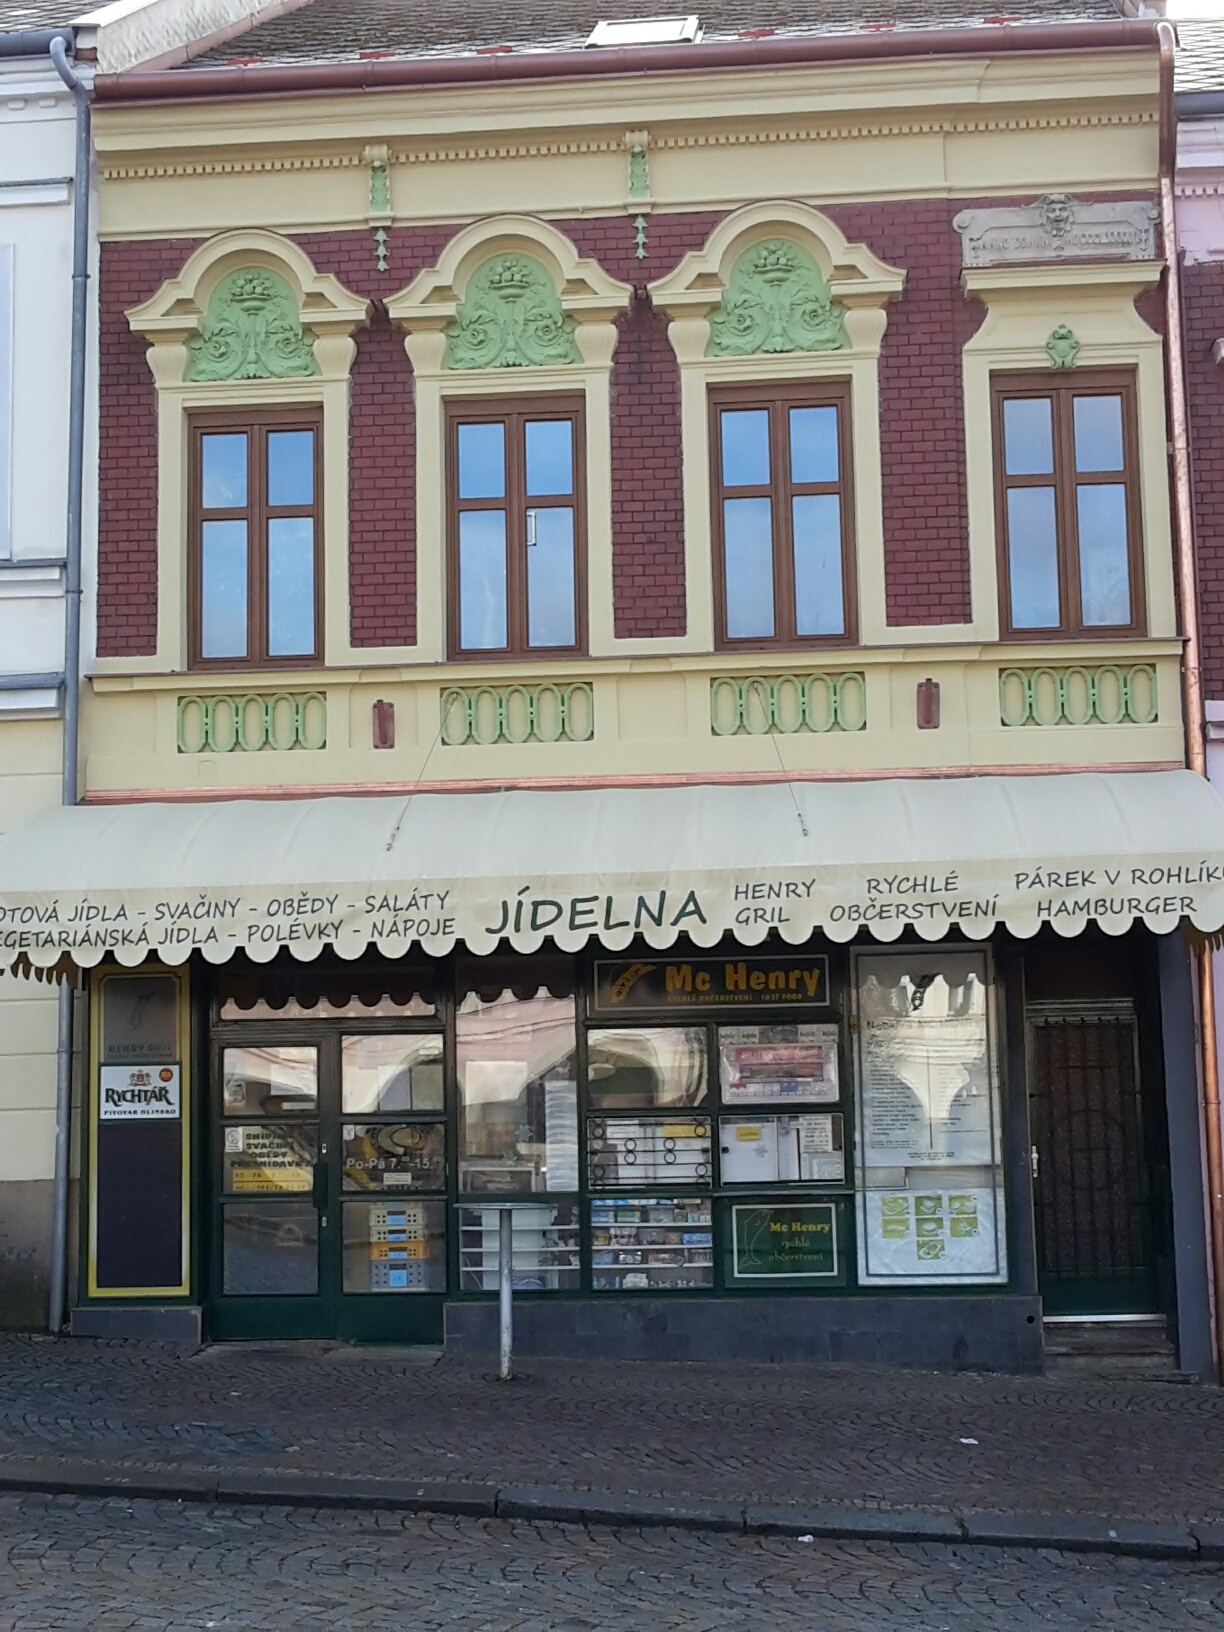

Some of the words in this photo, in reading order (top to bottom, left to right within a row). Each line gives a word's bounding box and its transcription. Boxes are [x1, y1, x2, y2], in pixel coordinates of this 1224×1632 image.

[866, 870, 960, 895] RYCHLÉ
[1015, 866, 1097, 890] PÁREK
[1104, 870, 1121, 886] V
[1131, 860, 1224, 885] ROHLÍK
[735, 879, 816, 901] HENRY
[67, 898, 128, 922] JÍDLA
[154, 894, 241, 921] SVAČINY
[266, 891, 339, 917] OBĚDY
[365, 887, 450, 914] SALÁTY
[485, 886, 707, 934] JÍDELNA
[830, 894, 1000, 922] OBČERSTVENÍ
[1036, 896, 1198, 918] HAMBURGER
[735, 907, 790, 926] GRIL
[0, 922, 149, 949] GETARIÁNSKÁ
[157, 920, 218, 945] JÍDLA
[247, 918, 344, 941] POLÉVKY
[371, 914, 456, 938] NÁPOJE
[665, 964, 711, 992] Mc
[725, 962, 821, 997] Henry
[760, 993, 780, 1001] FAST
[781, 993, 803, 1001] FOOD
[105, 1086, 176, 1107] RYCHTÁŘ
[346, 1157, 386, 1169] Po-Pá
[769, 1221, 788, 1232] Mc
[790, 1221, 831, 1233] Henry
